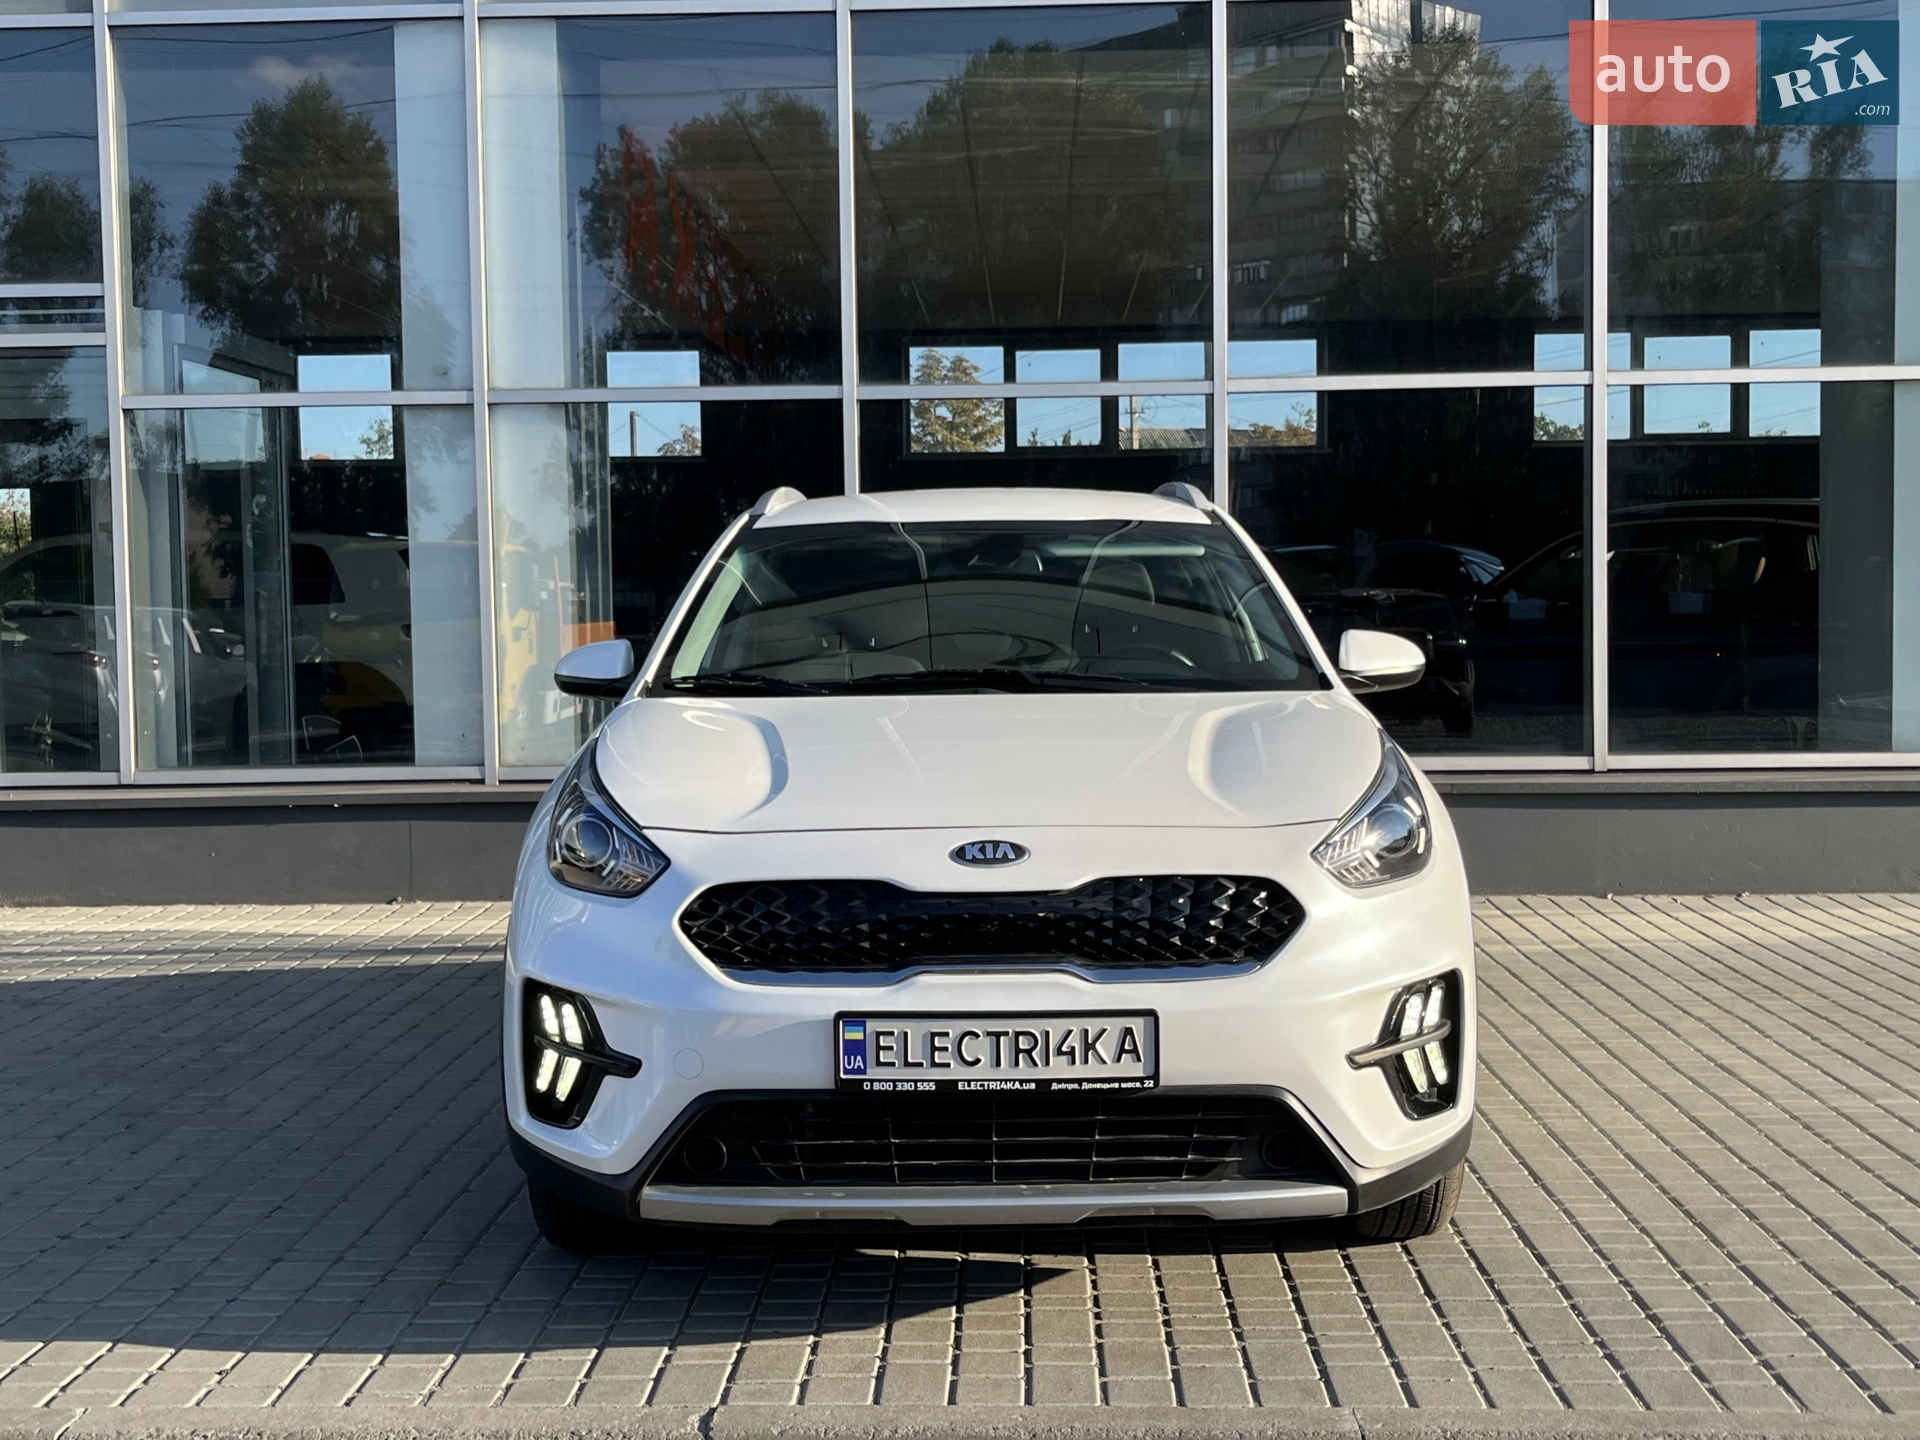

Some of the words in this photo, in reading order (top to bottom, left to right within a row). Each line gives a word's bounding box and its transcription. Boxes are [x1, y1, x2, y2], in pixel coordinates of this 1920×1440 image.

[964, 842, 1016, 860] KIA
[874, 1026, 1144, 1068] ELECTRI4KA
[844, 1054, 864, 1070] UA
[863, 1081, 871, 1091] 0
[873, 1081, 894, 1091] 800
[895, 1081, 915, 1091] 330
[917, 1081, 936, 1091] 555
[957, 1081, 1036, 1091] ELECTRI4KA.ua
[1143, 1080, 1155, 1088] 22
